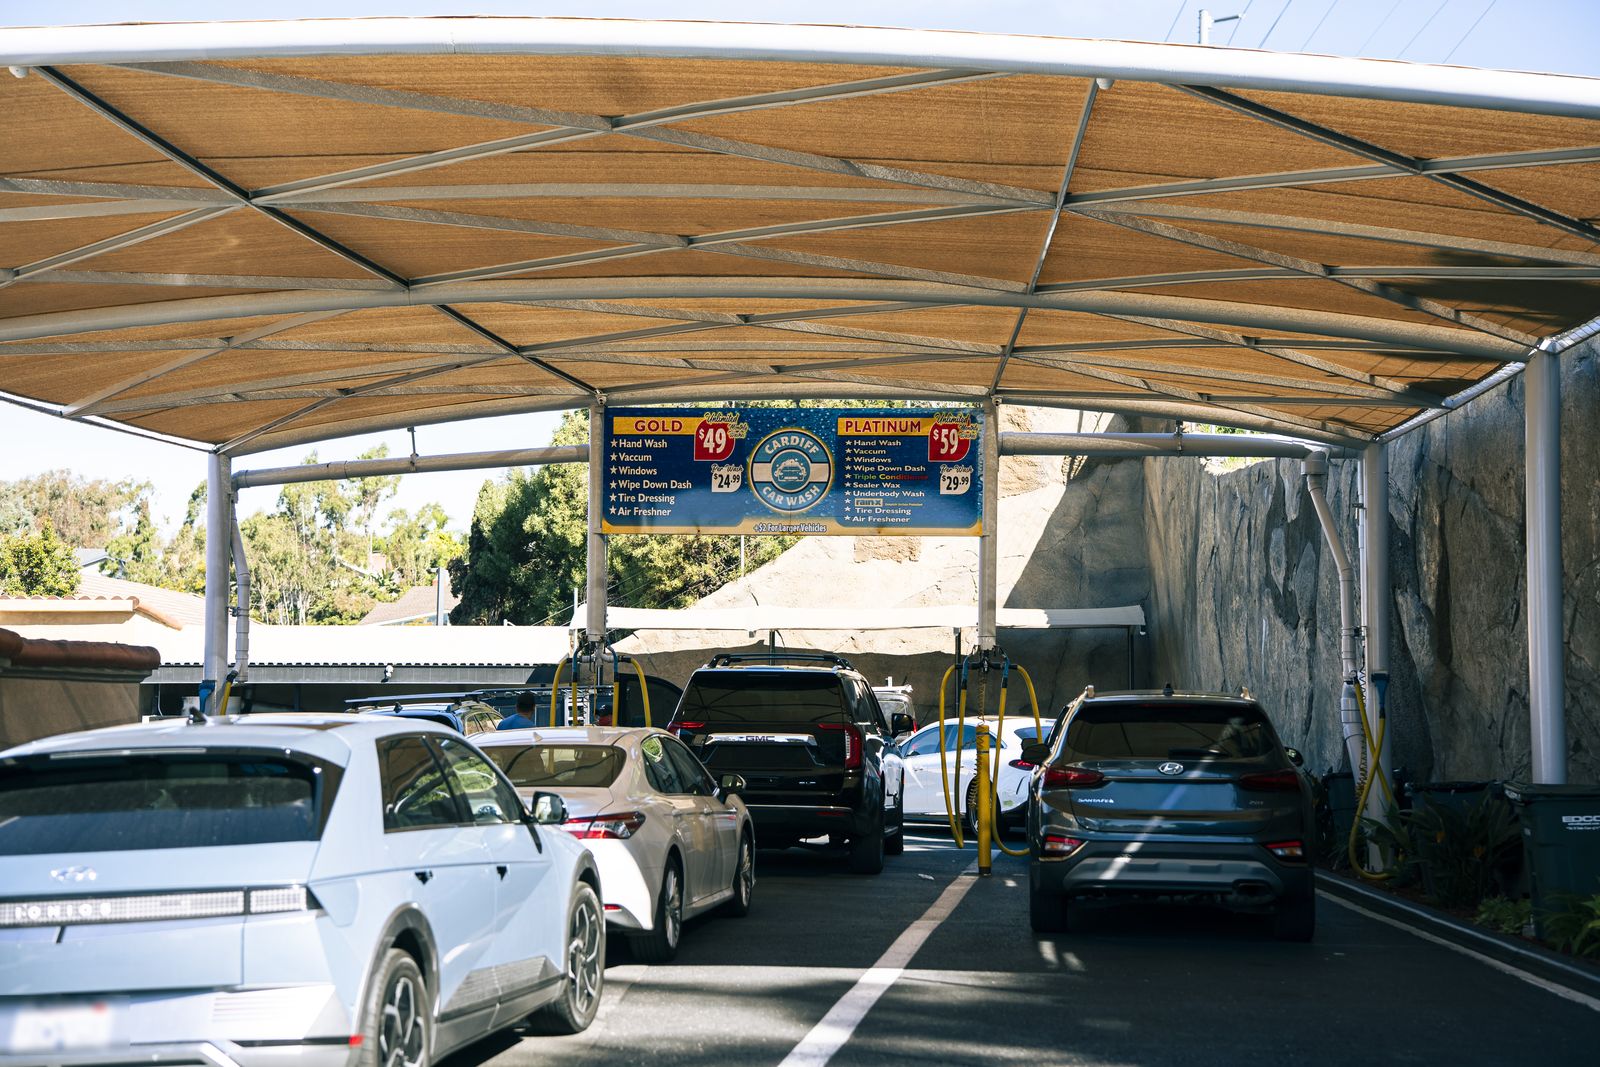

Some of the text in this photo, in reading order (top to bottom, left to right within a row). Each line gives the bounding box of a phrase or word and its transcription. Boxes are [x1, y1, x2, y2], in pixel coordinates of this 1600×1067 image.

[634, 419, 683, 432] GOLD
[845, 420, 921, 433] PLATINUM
[619, 438, 668, 448] Hand Wash
[698, 428, 727, 454] $49
[764, 435, 819, 454] CARDIFF
[933, 429, 959, 455] $59
[619, 452, 652, 462] Vaccum
[618, 466, 658, 475] Windows
[618, 480, 692, 491] Wipe Down Dash
[713, 473, 740, 489] $24.99
[942, 475, 969, 491] $29.99
[618, 493, 675, 505] Tire Dressing
[762, 484, 820, 506] CAR WASH
[852, 490, 900, 498] Underbody
[617, 507, 672, 516] Air Freshner
[874, 507, 912, 515] Dressing
[767, 524, 778, 532] For
[778, 524, 799, 533] Larger
[799, 524, 827, 532] Vehicles
